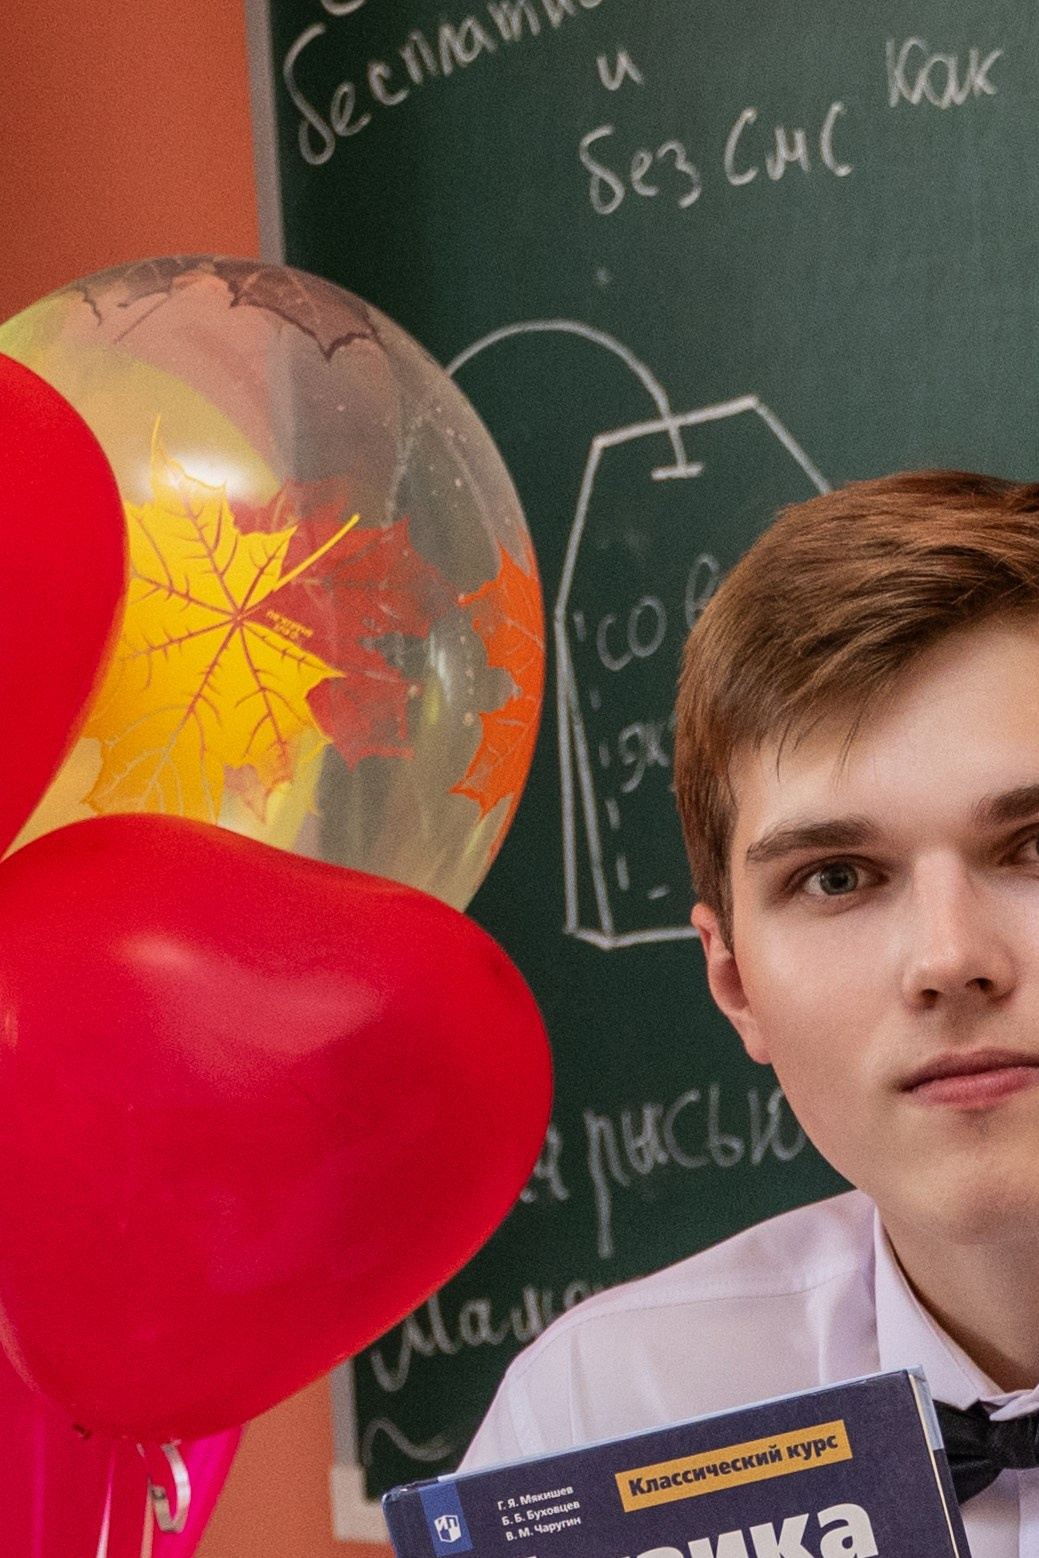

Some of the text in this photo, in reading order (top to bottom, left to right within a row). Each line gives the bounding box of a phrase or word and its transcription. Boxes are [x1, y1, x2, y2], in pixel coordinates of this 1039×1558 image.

[579, 125, 702, 214] без
[627, 1433, 839, 1498] Классический курс
[497, 1484, 575, 1511] Г. Я. Мякишев
[501, 1500, 581, 1526] Б. Б. Буховцев
[505, 1515, 582, 1542] В. М. Чаругин
